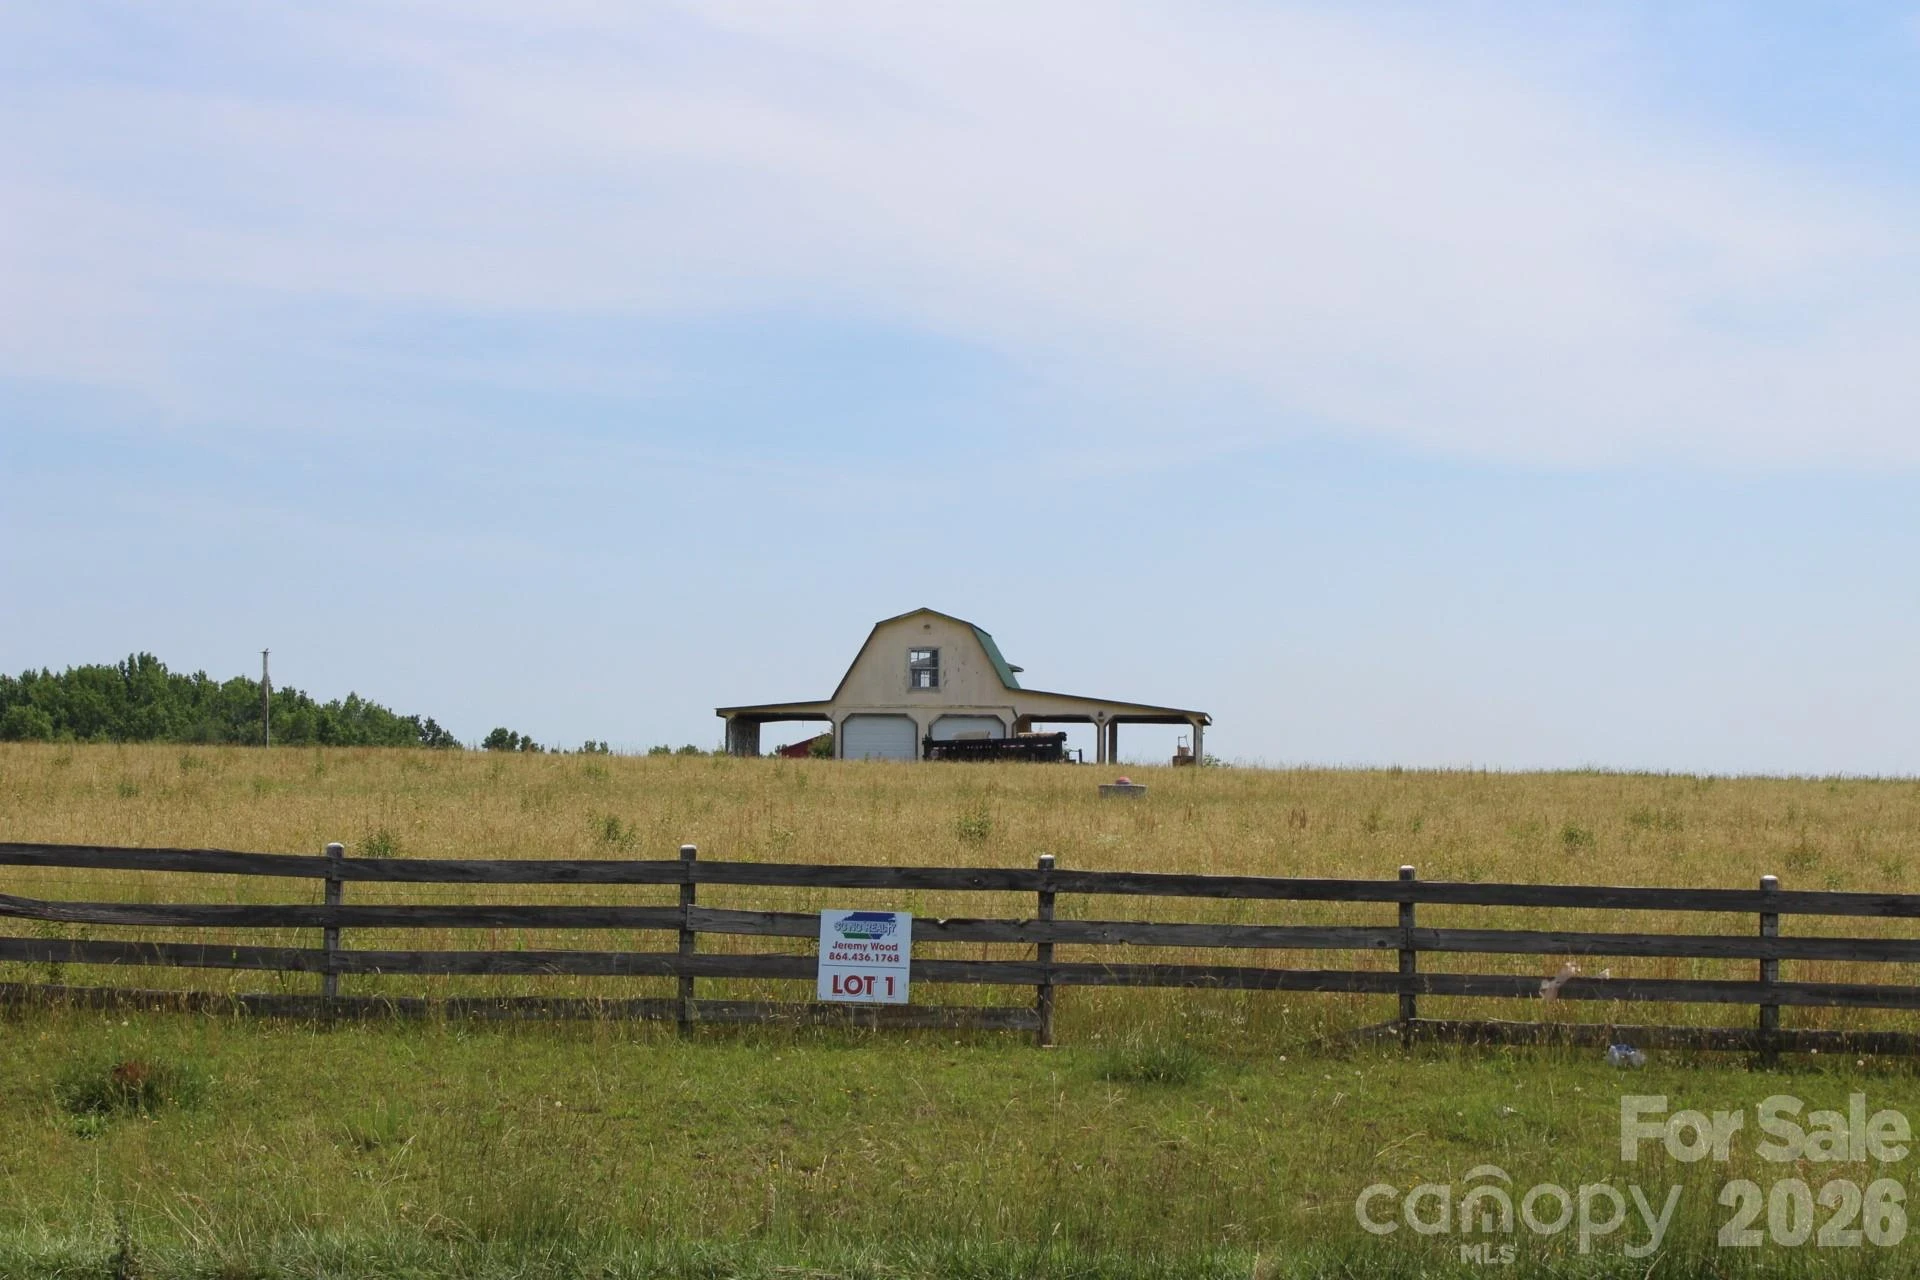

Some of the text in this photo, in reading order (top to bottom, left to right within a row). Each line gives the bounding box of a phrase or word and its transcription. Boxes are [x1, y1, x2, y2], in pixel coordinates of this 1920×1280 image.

[832, 941, 898, 952] Jeremy Wood
[829, 952, 900, 962] 864.436.1768
[832, 975, 896, 998] LOT 1
